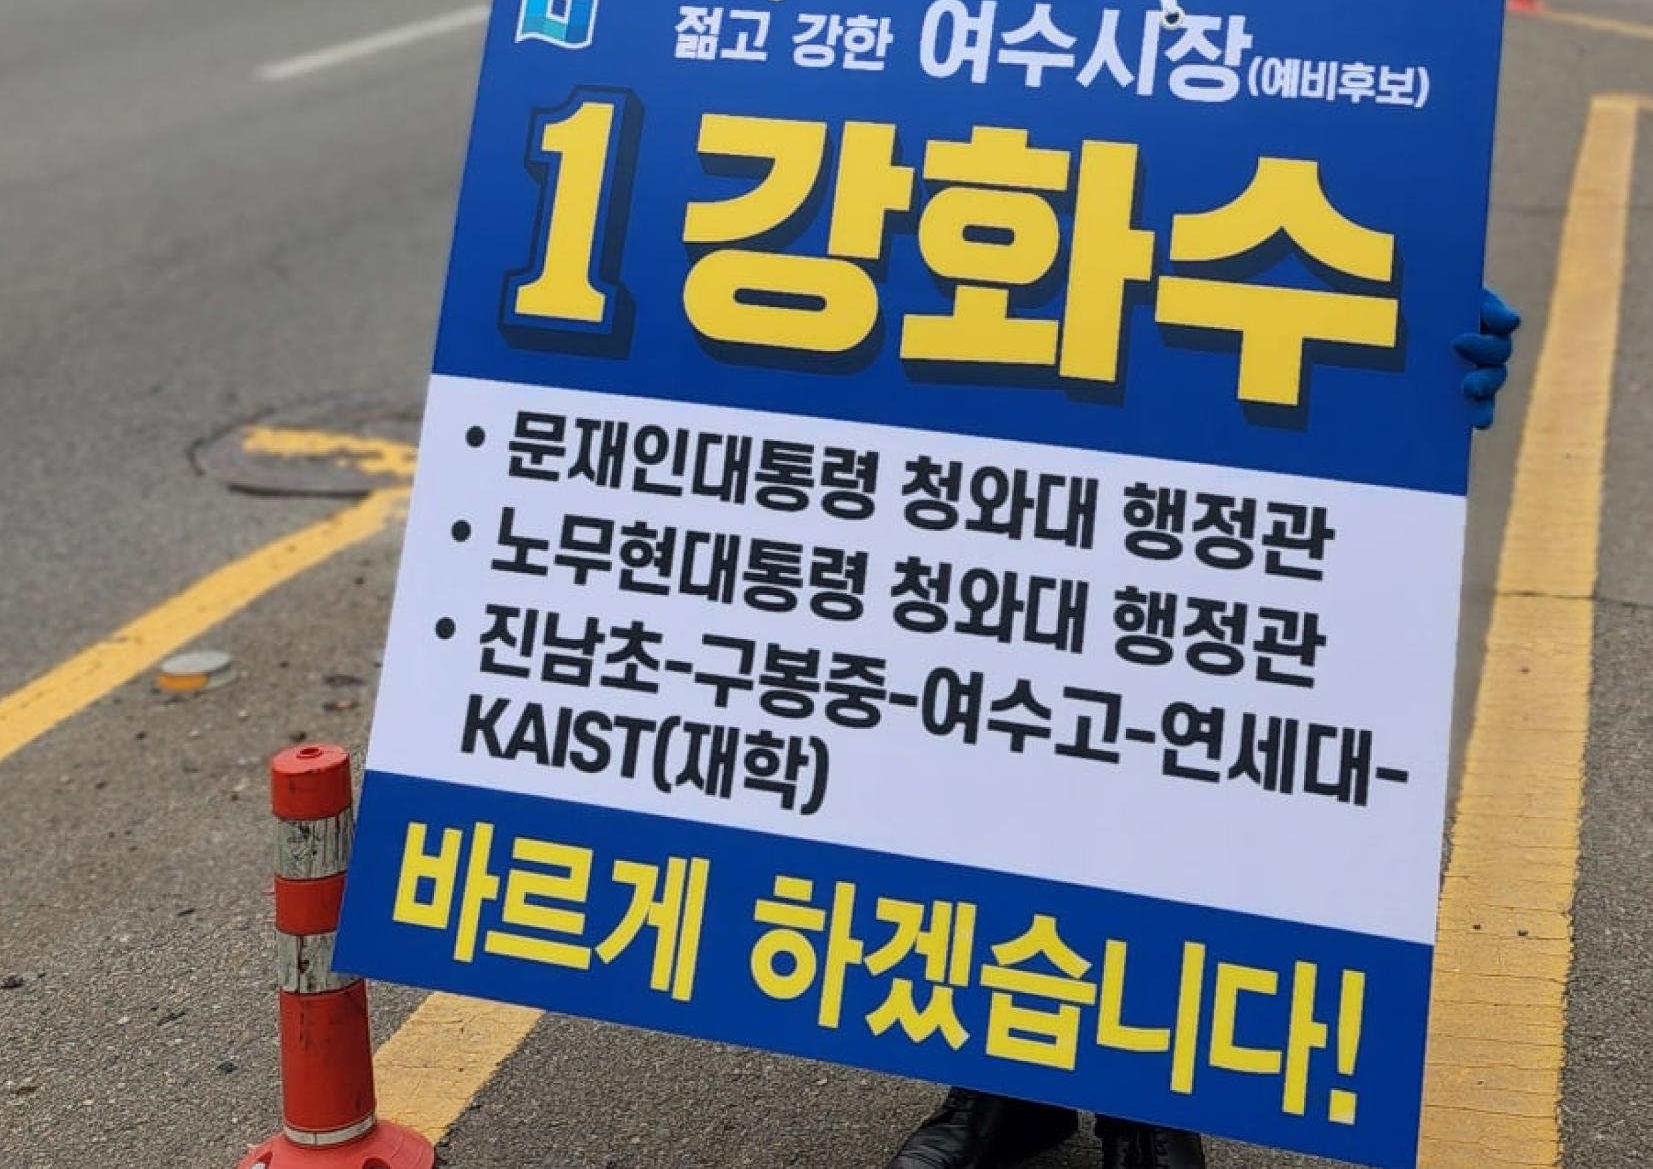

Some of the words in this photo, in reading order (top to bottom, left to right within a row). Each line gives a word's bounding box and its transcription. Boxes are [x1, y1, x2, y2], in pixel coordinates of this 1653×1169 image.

[674, 5, 771, 62] 젊고
[792, 13, 894, 71] 강한
[515, 102, 615, 323] 1
[682, 113, 1399, 406] 강화수
[508, 410, 879, 521] 문재인대통령
[901, 455, 1099, 550] 청와대
[1123, 482, 1336, 581] 행정관
[491, 506, 868, 622] 노무현대통령
[890, 556, 1089, 655] 청와대
[1113, 585, 1327, 689] 행정관
[460, 693, 831, 817] KAIST(재학)
[393, 821, 711, 1001] 바르게
[750, 875, 1366, 1124] 하겠습니다!
